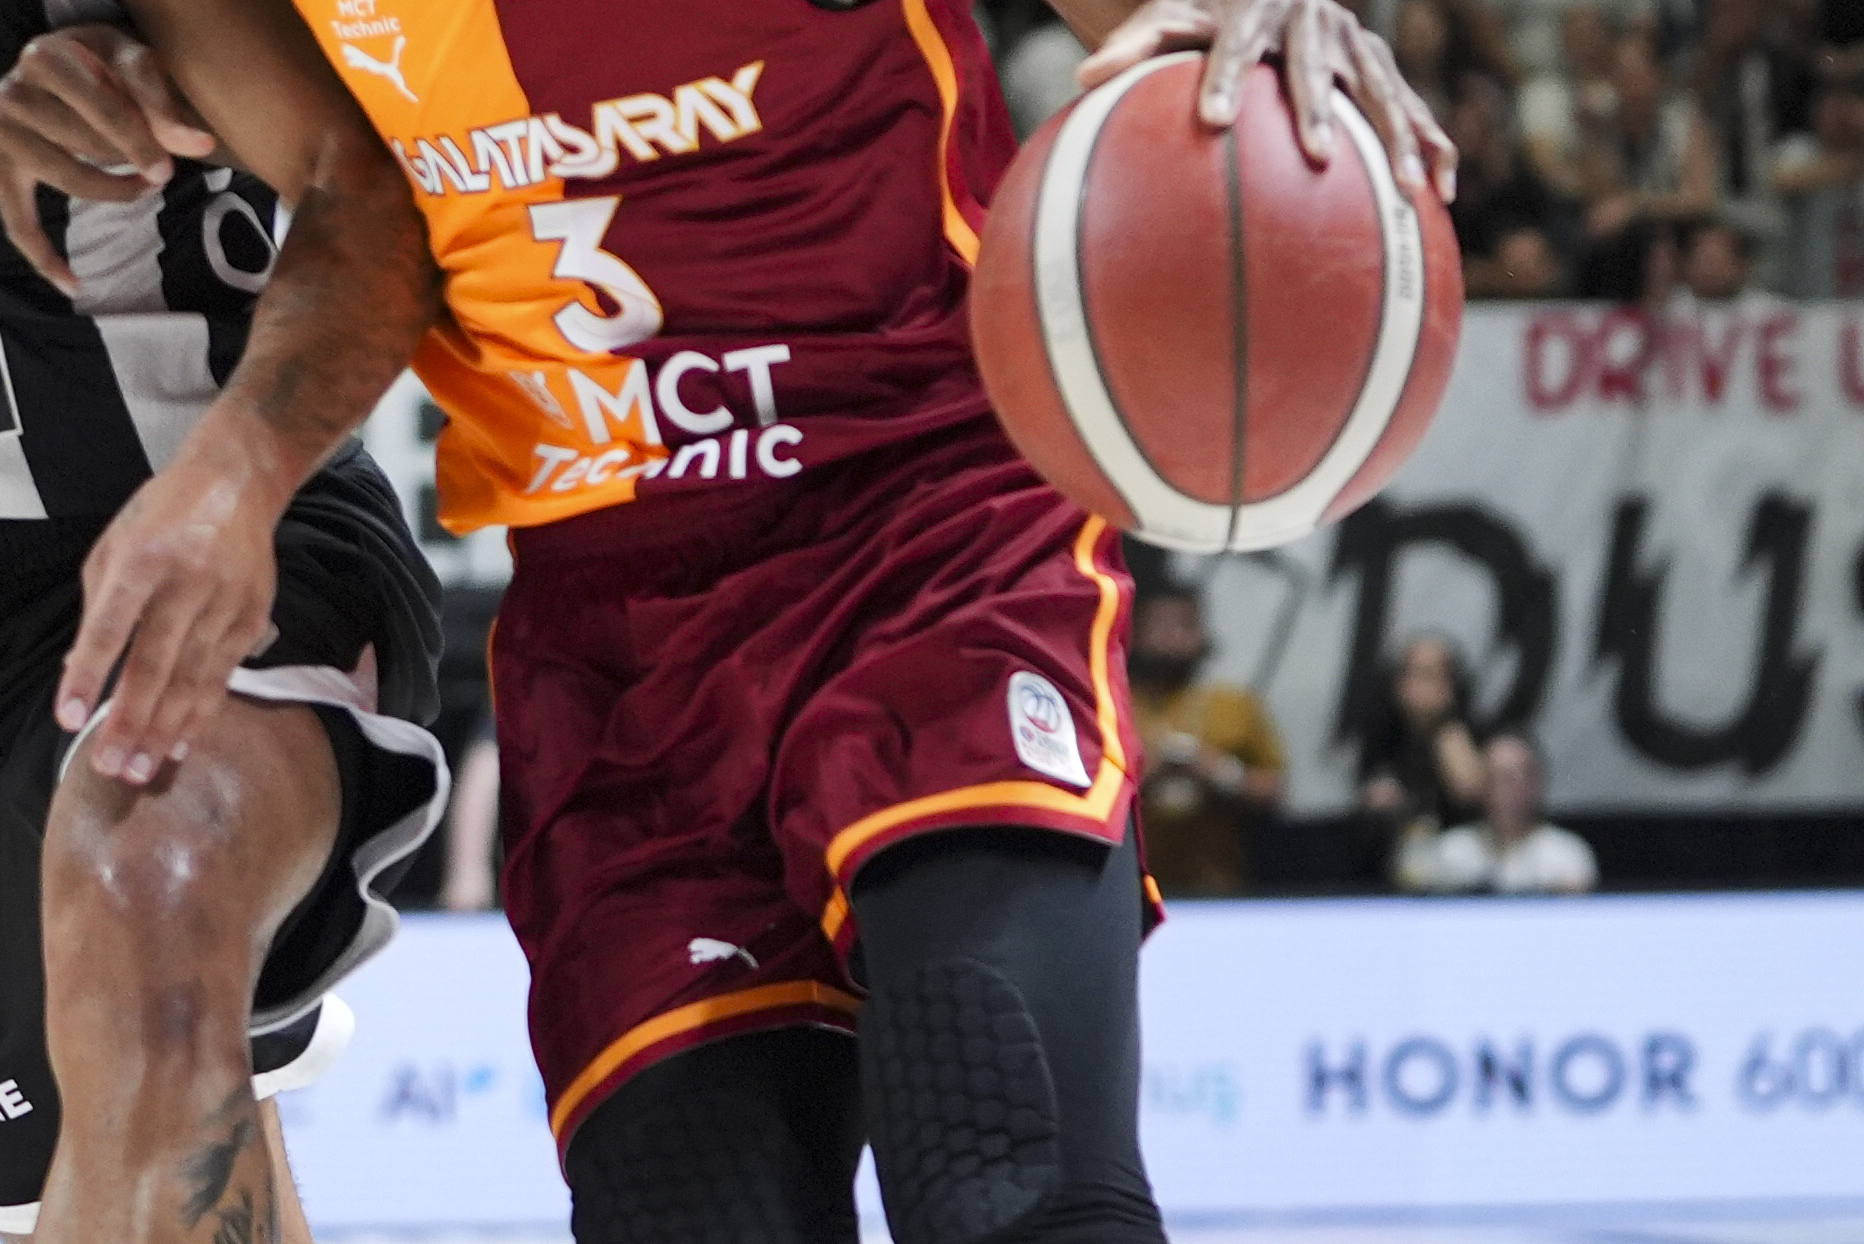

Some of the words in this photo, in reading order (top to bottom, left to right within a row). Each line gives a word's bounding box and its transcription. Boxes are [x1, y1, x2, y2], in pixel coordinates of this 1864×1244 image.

[330, 16, 401, 38] Technic
[529, 196, 663, 354] 3
[566, 343, 791, 446] MCT
[1522, 304, 1806, 416] DRIVE
[1302, 1032, 1700, 1118] HONOR
